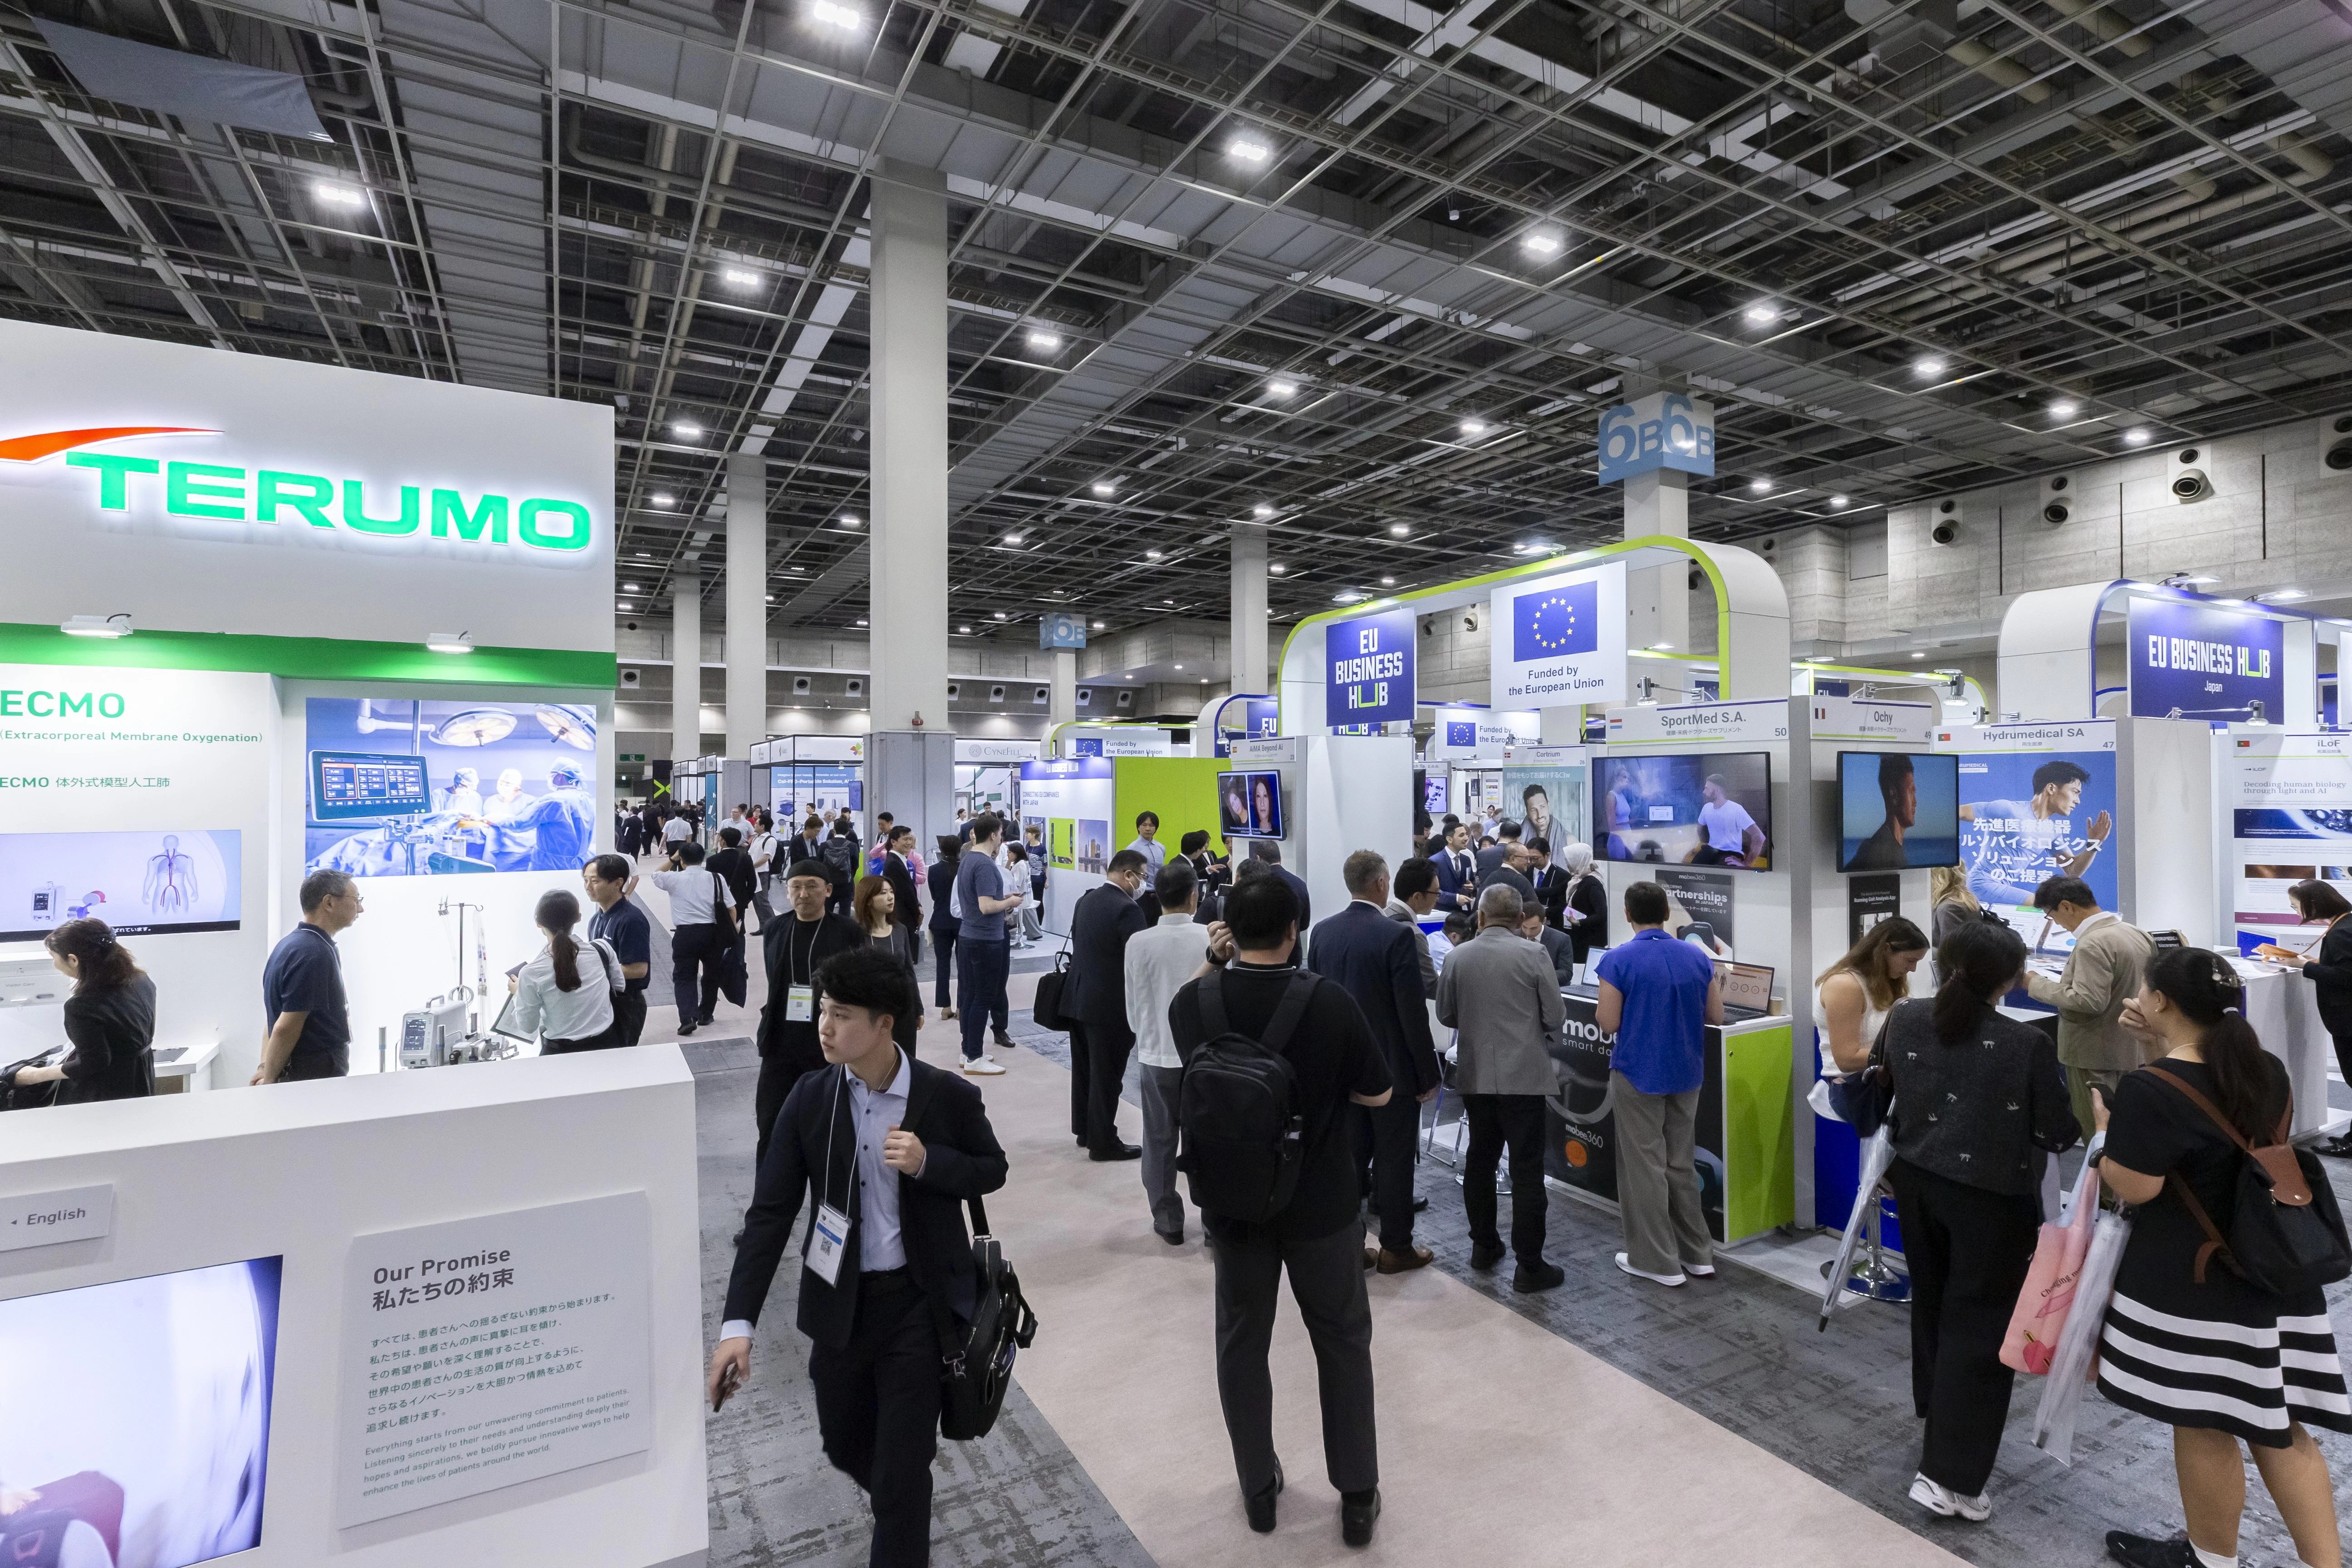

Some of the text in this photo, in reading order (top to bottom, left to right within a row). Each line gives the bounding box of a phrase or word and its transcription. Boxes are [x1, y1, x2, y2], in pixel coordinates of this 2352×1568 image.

[66, 451, 591, 551] TERUMO
[1360, 628, 1378, 654] EU
[1336, 652, 1403, 685] BUSINESS
[2149, 635, 2270, 678] EU BUSINESS HUB
[1528, 666, 1578, 680] Funded by
[1348, 681, 1388, 709] HUB
[1509, 677, 1604, 696] the European Union
[2205, 681, 2222, 693] Japan
[0, 690, 125, 718] ECMO
[1262, 718, 1277, 733] EU
[1661, 711, 1746, 728] SportMed S.A.
[1874, 711, 1892, 725] Ochy
[0, 729, 262, 743] (Extracorporeal Membrane Oxygenation)
[1775, 728, 1787, 736] 50
[1984, 728, 2084, 742] Hydrumedical SA
[1262, 745, 1277, 753] Beyond
[0, 777, 170, 788] ECMO 体外式模型人工肺
[1960, 834, 2102, 852] ルソバイオロジクス
[1972, 851, 2074, 867] ソリューション
[1664, 889, 1727, 904] artnerships
[1563, 1038, 1612, 1056] smart da
[1566, 1124, 1603, 1148] mobee360
[27, 1208, 86, 1226] English
[374, 1250, 510, 1284] Our Promise
[373, 1268, 514, 1311] 私たちの約束
[369, 1338, 544, 1381] その希望や願いを深く理解することで、
[368, 1346, 583, 1398] 世界中の患者さんの生活の質が向上するように、
[368, 1360, 583, 1415] さらなるイノベーションを大胆かつ情熱を込めて
[366, 1409, 446, 1433] 追求し続けます。
[366, 1439, 412, 1455] Everything
[416, 1433, 442, 1443] starts
[445, 1428, 465, 1436] from
[485, 1411, 532, 1427] unwavering
[535, 1399, 584, 1415] commitment
[597, 1388, 629, 1402] patients.
[364, 1455, 405, 1469] Listening
[408, 1444, 446, 1459] sincerely
[460, 1436, 479, 1446] their
[482, 1430, 506, 1441] needs
[509, 1425, 523, 1434] and
[526, 1411, 583, 1430] understanding
[585, 1405, 610, 1416] deeply
[612, 1400, 629, 1409] their
[364, 1472, 391, 1483] hopes
[394, 1465, 410, 1475] and
[412, 1455, 463, 1470] aspirations,
[481, 1443, 506, 1454] boldly
[509, 1436, 537, 1449] pursue
[540, 1425, 579, 1439] innovative
[582, 1420, 601, 1429] ways
[613, 1412, 630, 1421] help
[363, 1444, 550, 1496] enhance the lives of patients around the world.
